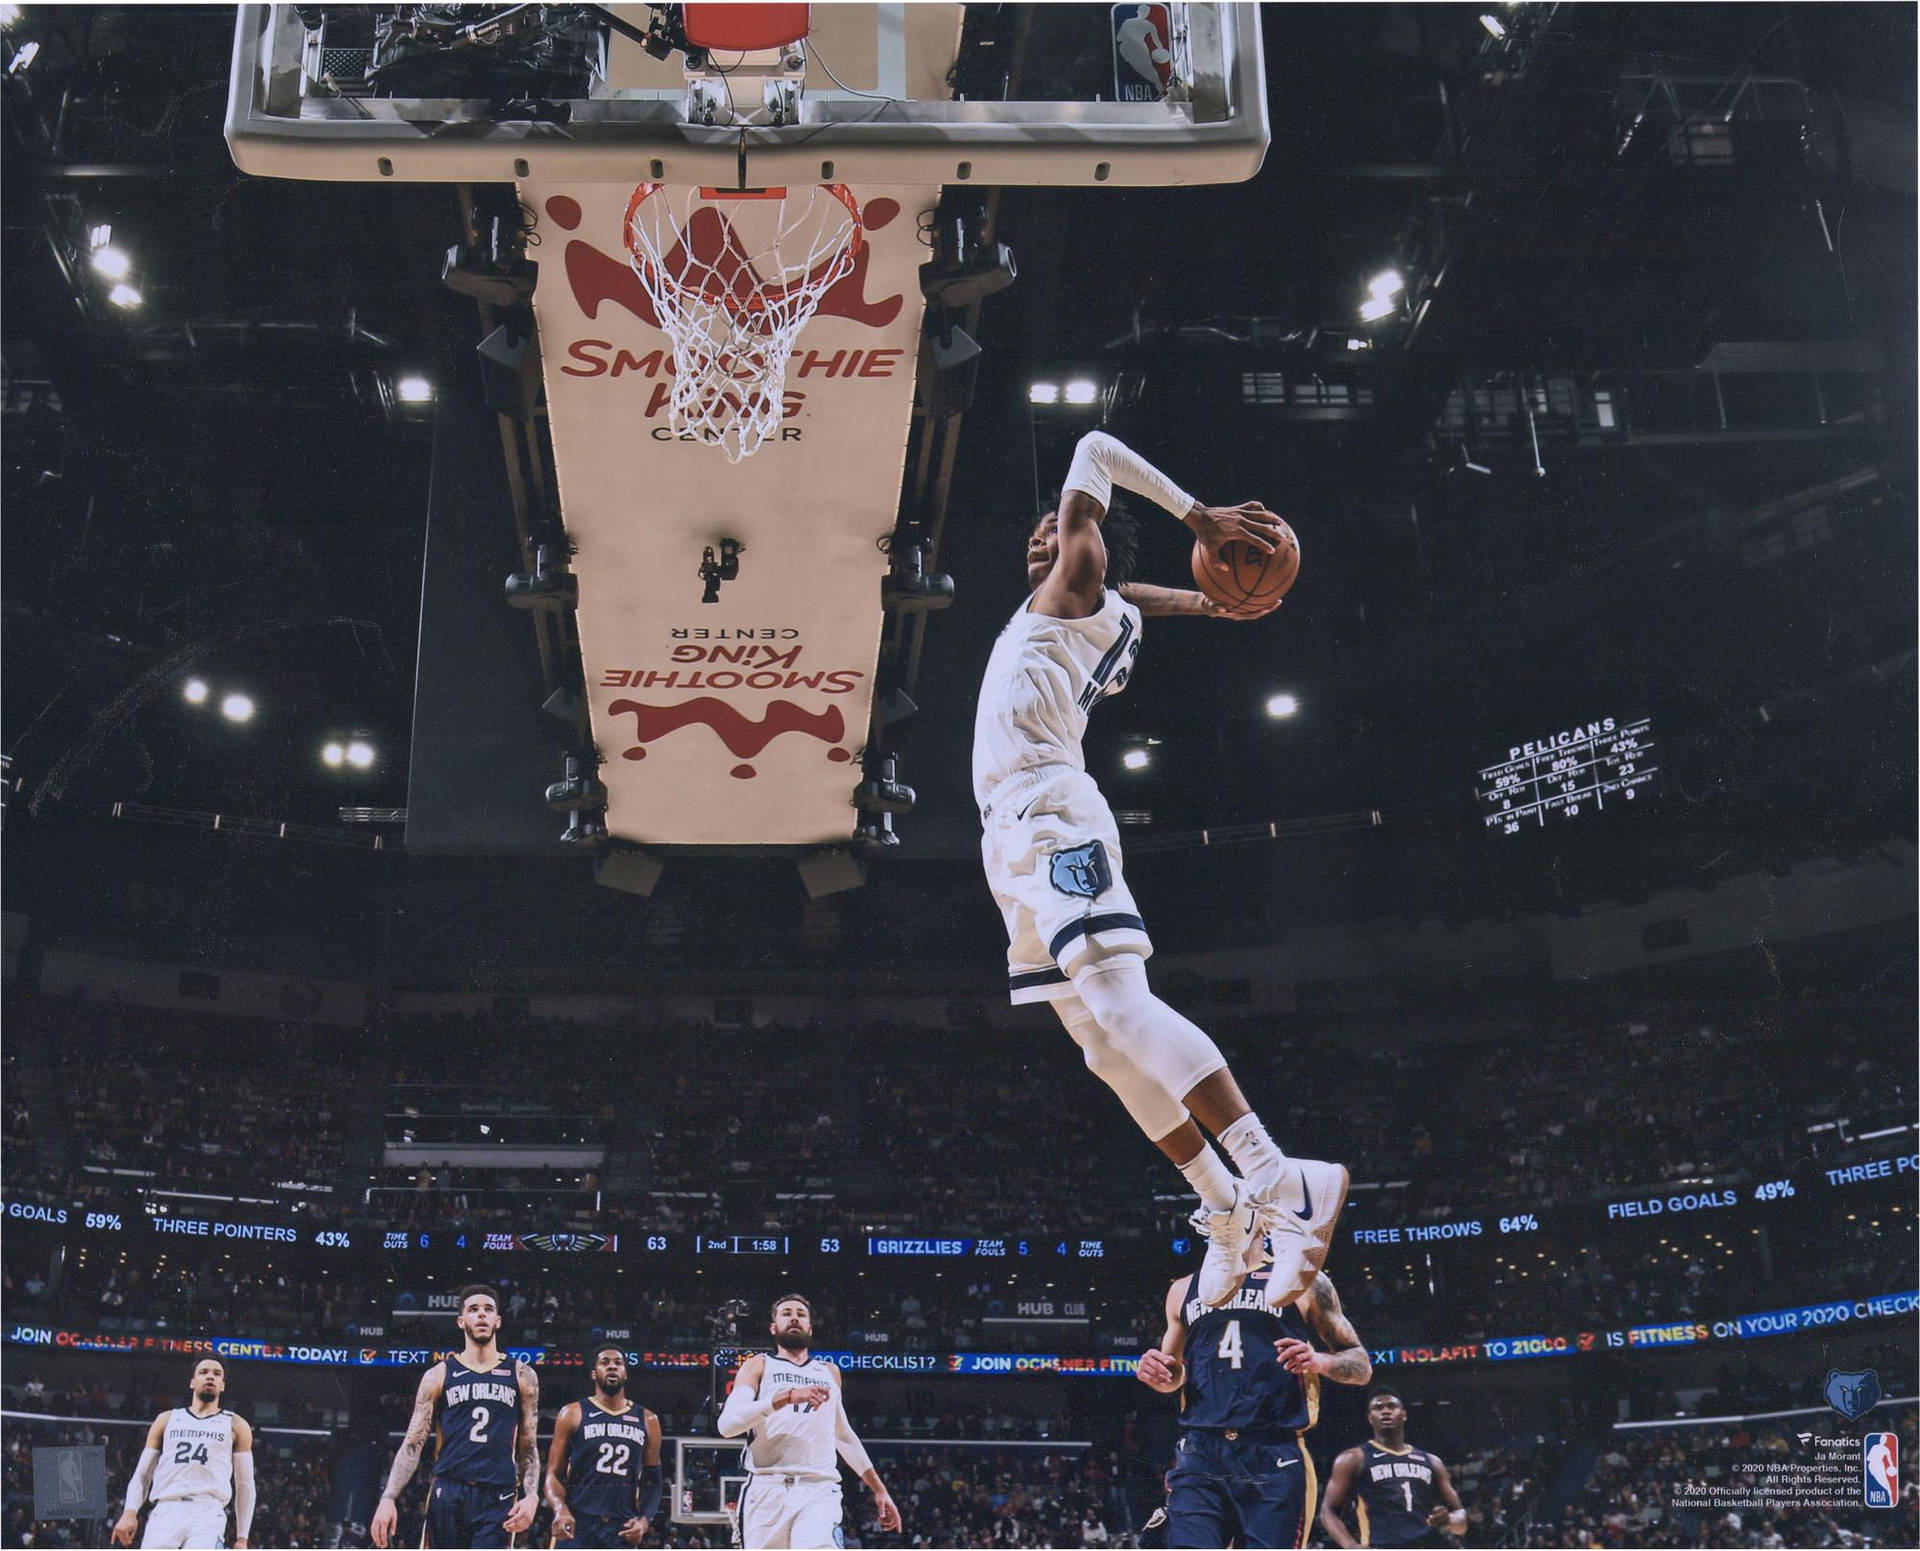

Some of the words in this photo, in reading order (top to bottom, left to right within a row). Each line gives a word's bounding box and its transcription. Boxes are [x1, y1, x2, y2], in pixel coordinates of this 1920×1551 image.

[1124, 85, 1153, 101] NBA
[671, 628, 800, 640] CENTER
[599, 669, 865, 694] SMOOTHIE
[1509, 717, 1616, 762] PELICANS
[1610, 737, 1638, 753] 43%
[1618, 762, 1635, 776] 23
[1495, 773, 1521, 788] 59%
[1560, 779, 1576, 793] 15
[1625, 788, 1635, 800] 9
[1502, 799, 1511, 810] 8
[1563, 804, 1579, 817] 10
[1504, 821, 1520, 835] 36
[1825, 1159, 1893, 1186] THREE
[1608, 1199, 1664, 1219] FIELD
[1667, 1190, 1737, 1213] GOALS
[1754, 1180, 1796, 1201] 49%
[9, 1202, 68, 1224] GOALS
[85, 1212, 122, 1231] 59%
[153, 1217, 209, 1236] THREE
[213, 1222, 298, 1243] POINTERS
[315, 1231, 351, 1249] 43%
[1353, 1229, 1401, 1245] FREE
[1405, 1220, 1483, 1242] THROWS
[1498, 1214, 1539, 1233] 64%
[385, 1232, 408, 1240] TIME
[420, 1234, 430, 1249] 6
[456, 1235, 467, 1249] 4
[486, 1234, 512, 1242] TEAM
[383, 1240, 409, 1249] OUTS
[483, 1242, 514, 1250] FOULS
[646, 1236, 667, 1251] 63
[707, 1239, 727, 1250] 2nd
[752, 1239, 777, 1252] 1:58
[820, 1238, 840, 1253] 53
[877, 1241, 963, 1255] GRIZZLIES
[978, 1240, 1004, 1249] TEAM
[1018, 1241, 1028, 1255] 5
[1056, 1242, 1067, 1255] 4
[1079, 1241, 1103, 1249] TIME
[975, 1248, 1006, 1257] FOULS
[1078, 1248, 1104, 1257] OUTS
[1017, 1303, 1055, 1315] HUB
[1063, 1303, 1087, 1316] CLUB
[360, 1326, 384, 1336] HUB
[605, 1329, 630, 1339] HUB
[864, 1332, 888, 1342] HUB
[1483, 1341, 1508, 1358] TO
[1606, 1331, 1624, 1347] IS
[1628, 1324, 1709, 1344] FITNESS
[1713, 1321, 1743, 1339] ON
[1746, 1313, 1798, 1334] YOUR
[11, 1326, 52, 1344] JOIN
[217, 1341, 283, 1359] CENTER
[288, 1346, 348, 1363] TODAY!
[1113, 1336, 1139, 1347] HUB
[1218, 1319, 1245, 1369] 4
[388, 1350, 429, 1364] TEXT
[971, 1356, 1012, 1371] JOIN
[446, 1383, 470, 1407] NEW
[472, 1382, 517, 1408] ORLEANS
[469, 1406, 490, 1443] 2
[169, 1428, 225, 1442] MEMPHIS
[584, 1422, 606, 1440] NEW
[607, 1422, 646, 1446] ORLEANS
[174, 1441, 209, 1466] 24
[595, 1442, 630, 1477] 22
[1400, 1480, 1413, 1512] 1
